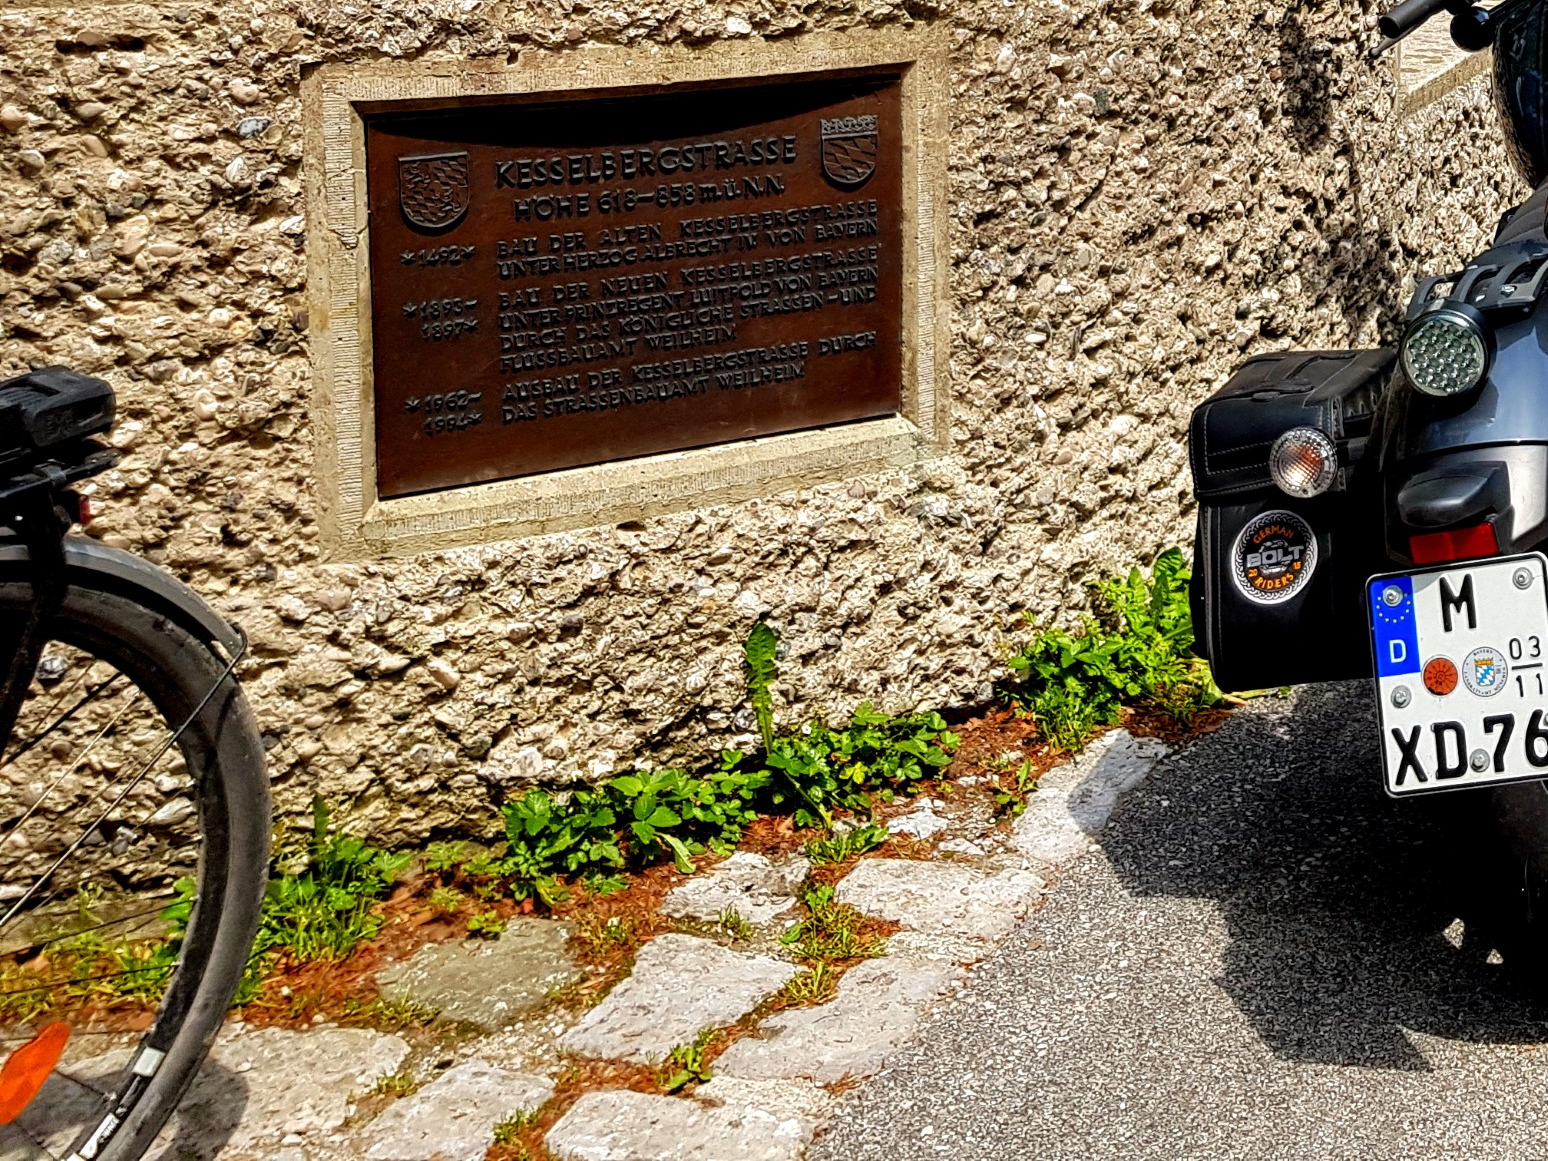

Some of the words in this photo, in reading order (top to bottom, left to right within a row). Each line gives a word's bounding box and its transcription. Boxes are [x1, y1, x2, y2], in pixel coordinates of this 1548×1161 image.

[495, 135, 798, 189] KESSELBERGSTRASSE
[498, 236, 538, 260] BAU
[549, 231, 587, 253] DER
[599, 223, 662, 246] ALTEN
[679, 199, 878, 238] KESSELBERGSTRASSE
[513, 192, 592, 222] HÖHE
[497, 255, 560, 281] UNTER
[562, 246, 638, 272] HERZOG
[640, 235, 734, 263] ALBRECHT
[767, 225, 806, 247] VON
[814, 218, 878, 241] BAYERN
[499, 287, 541, 310] BAU
[552, 282, 591, 302] DER
[601, 271, 669, 297] NEUEN
[680, 245, 878, 287] KESSELBERGSTRASSE
[499, 308, 561, 332] UNTER
[564, 289, 684, 323] PRINZREGENT
[690, 279, 773, 308] LUITPOLD
[774, 272, 811, 291] VON
[817, 265, 879, 288] BAYERN
[499, 327, 567, 353] DURCH
[575, 321, 611, 342] DAS
[618, 302, 734, 335] KÖNIGLICHE
[500, 338, 637, 373] FLUSSBAUAMT
[645, 324, 737, 354] WEILHEIM
[503, 374, 580, 403] AUSBAU
[587, 368, 623, 388] DER
[630, 341, 809, 383] KESSELBERGSTRASSE
[818, 331, 878, 355] DURCH
[502, 401, 538, 426] DAS
[543, 376, 711, 416] STRASSENBAUAMT
[715, 361, 806, 392] WEILHEIM
[1246, 545, 1305, 568] BOLT
[1252, 524, 1295, 545] GERMAN
[1254, 572, 1295, 590] RIDERS
[1439, 573, 1477, 632] M
[1389, 639, 1407, 663] D
[1508, 635, 1541, 661] 03
[1515, 672, 1544, 698] 11
